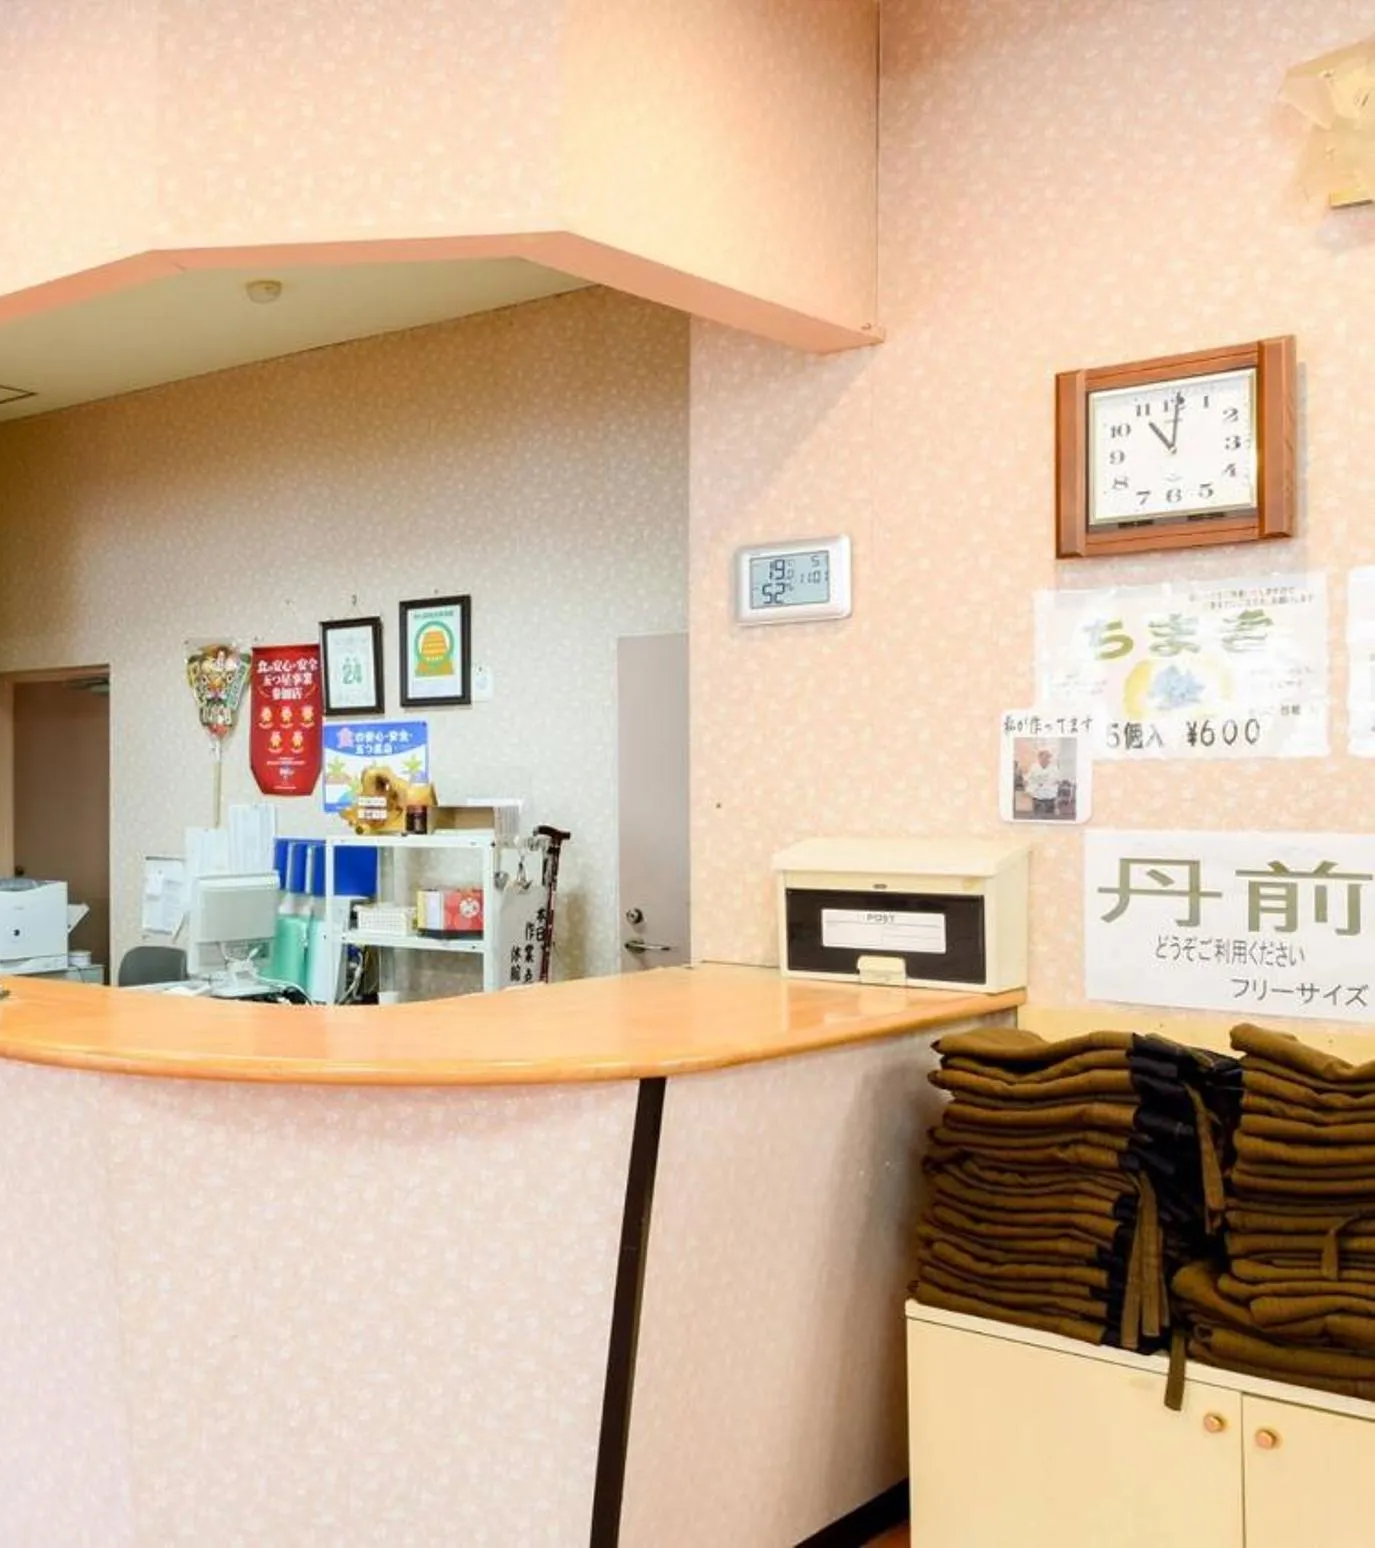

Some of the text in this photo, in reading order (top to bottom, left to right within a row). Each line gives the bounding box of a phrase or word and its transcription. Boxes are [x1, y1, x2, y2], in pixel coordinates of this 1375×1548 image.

[1204, 395, 1209, 409] 1
[1136, 403, 1150, 417] 11
[1223, 408, 1239, 422] 2
[1110, 423, 1131, 438] 10
[1225, 435, 1241, 450] 3
[1109, 450, 1125, 465] 9
[1223, 463, 1237, 477] 4
[1112, 476, 1129, 490] 8
[1198, 483, 1214, 498] 5
[1136, 490, 1151, 505] 7
[1165, 488, 1182, 503] 6
[1083, 609, 1274, 661] ちまき
[1107, 718, 1261, 749] 5個入 ¥600
[1097, 857, 1373, 936] 丹前
[1155, 936, 1306, 968] どうぞご利用ください
[1231, 977, 1369, 1007] フリーサイズ
